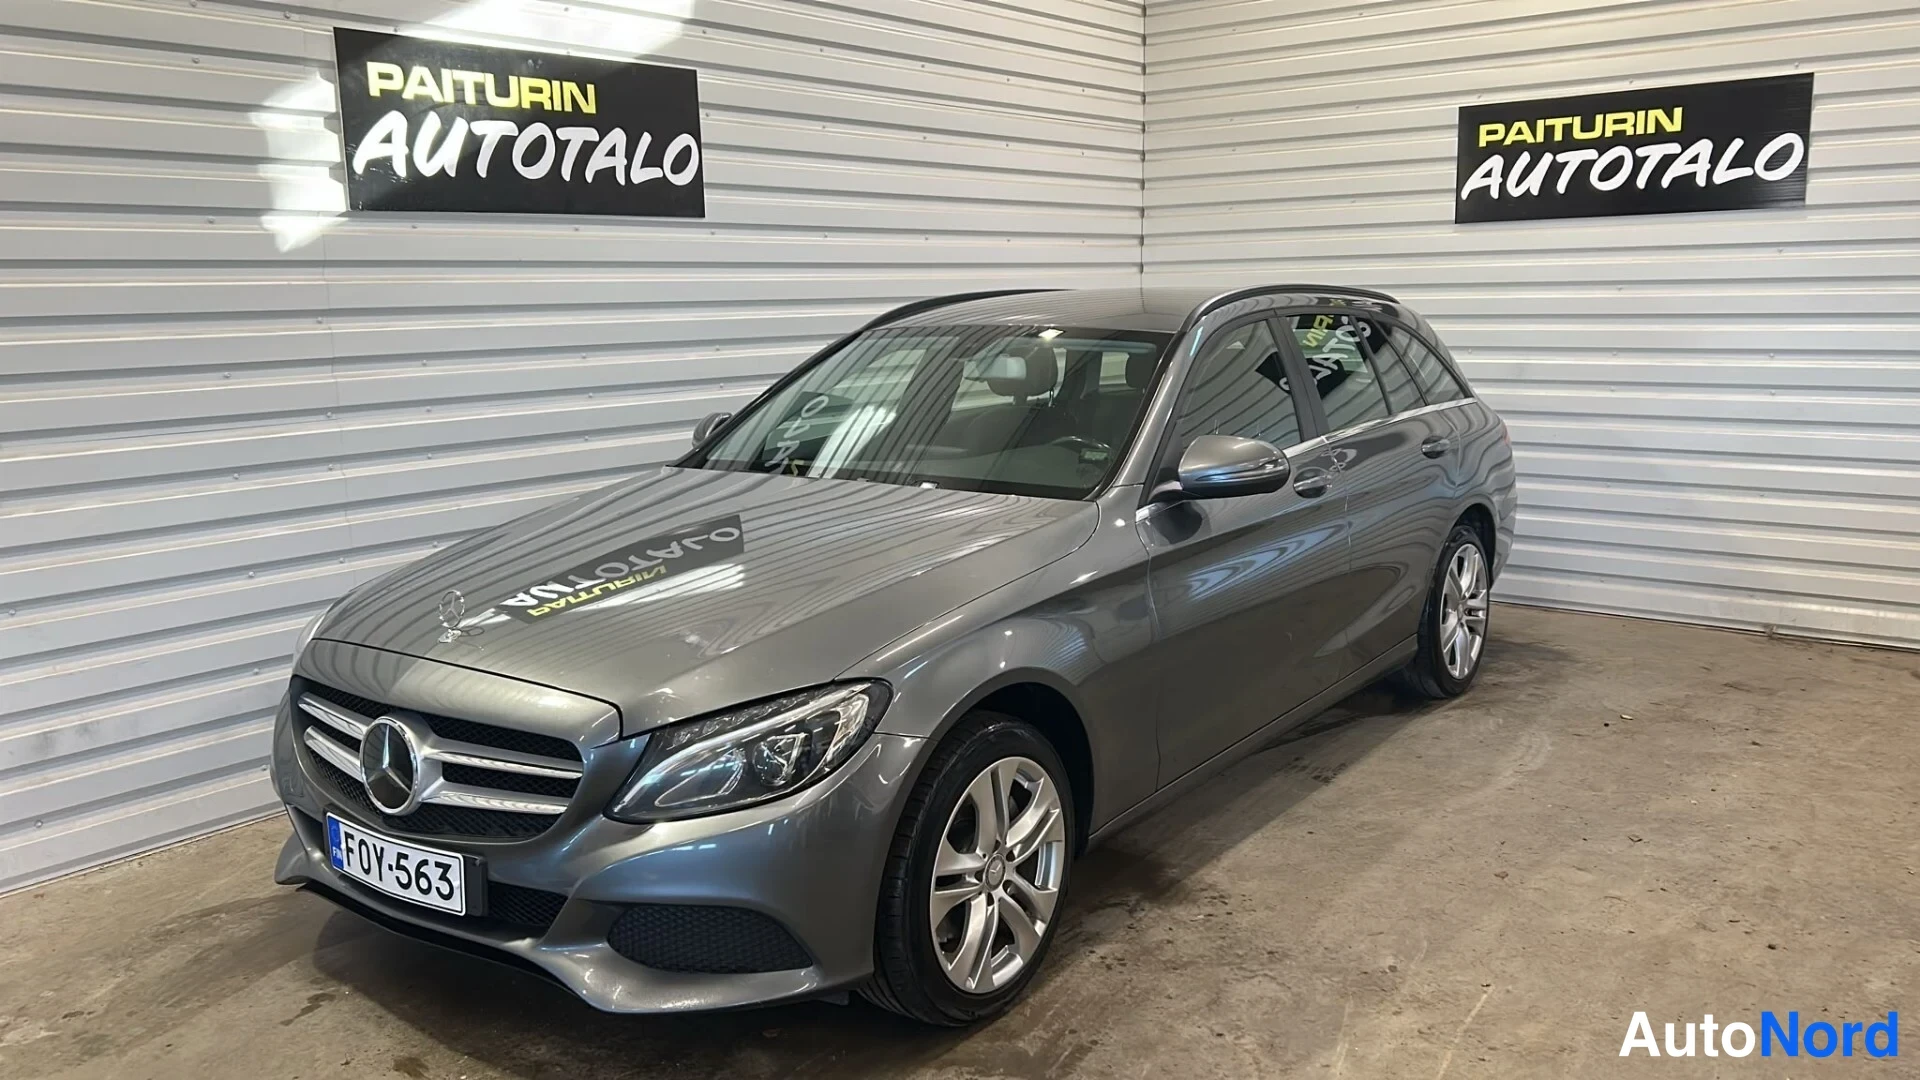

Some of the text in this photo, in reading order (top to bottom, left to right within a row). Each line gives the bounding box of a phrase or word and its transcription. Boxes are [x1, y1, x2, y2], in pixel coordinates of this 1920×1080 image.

[366, 61, 597, 115] PAITURIN
[352, 109, 700, 187] AUTOTALO
[1478, 106, 1684, 148] PAITURIN
[1460, 132, 1806, 201] AUTOTALO
[344, 830, 455, 901] FOY-563
